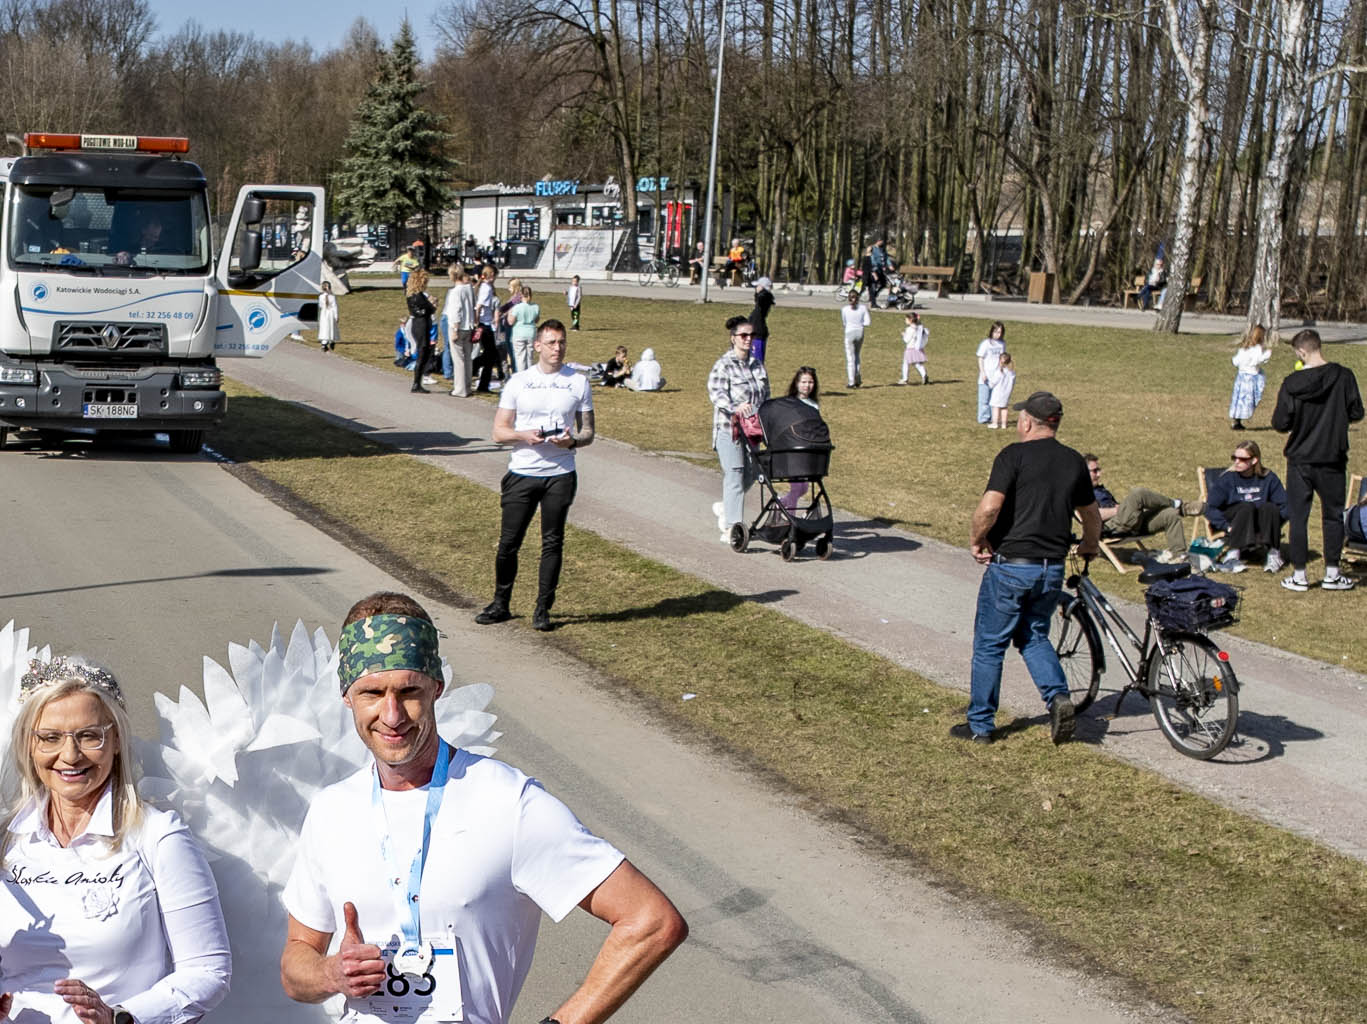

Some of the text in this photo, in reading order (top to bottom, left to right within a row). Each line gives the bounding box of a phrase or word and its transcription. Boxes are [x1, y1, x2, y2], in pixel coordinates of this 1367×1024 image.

[56, 286, 92, 294] Katowickie
[94, 287, 128, 296] Wodociągi
[129, 311, 145, 319] tel.:
[157, 312, 171, 320] 256
[173, 312, 182, 320] 48
[90, 405, 135, 416] SK 188NG
[370, 959, 437, 997] 83
